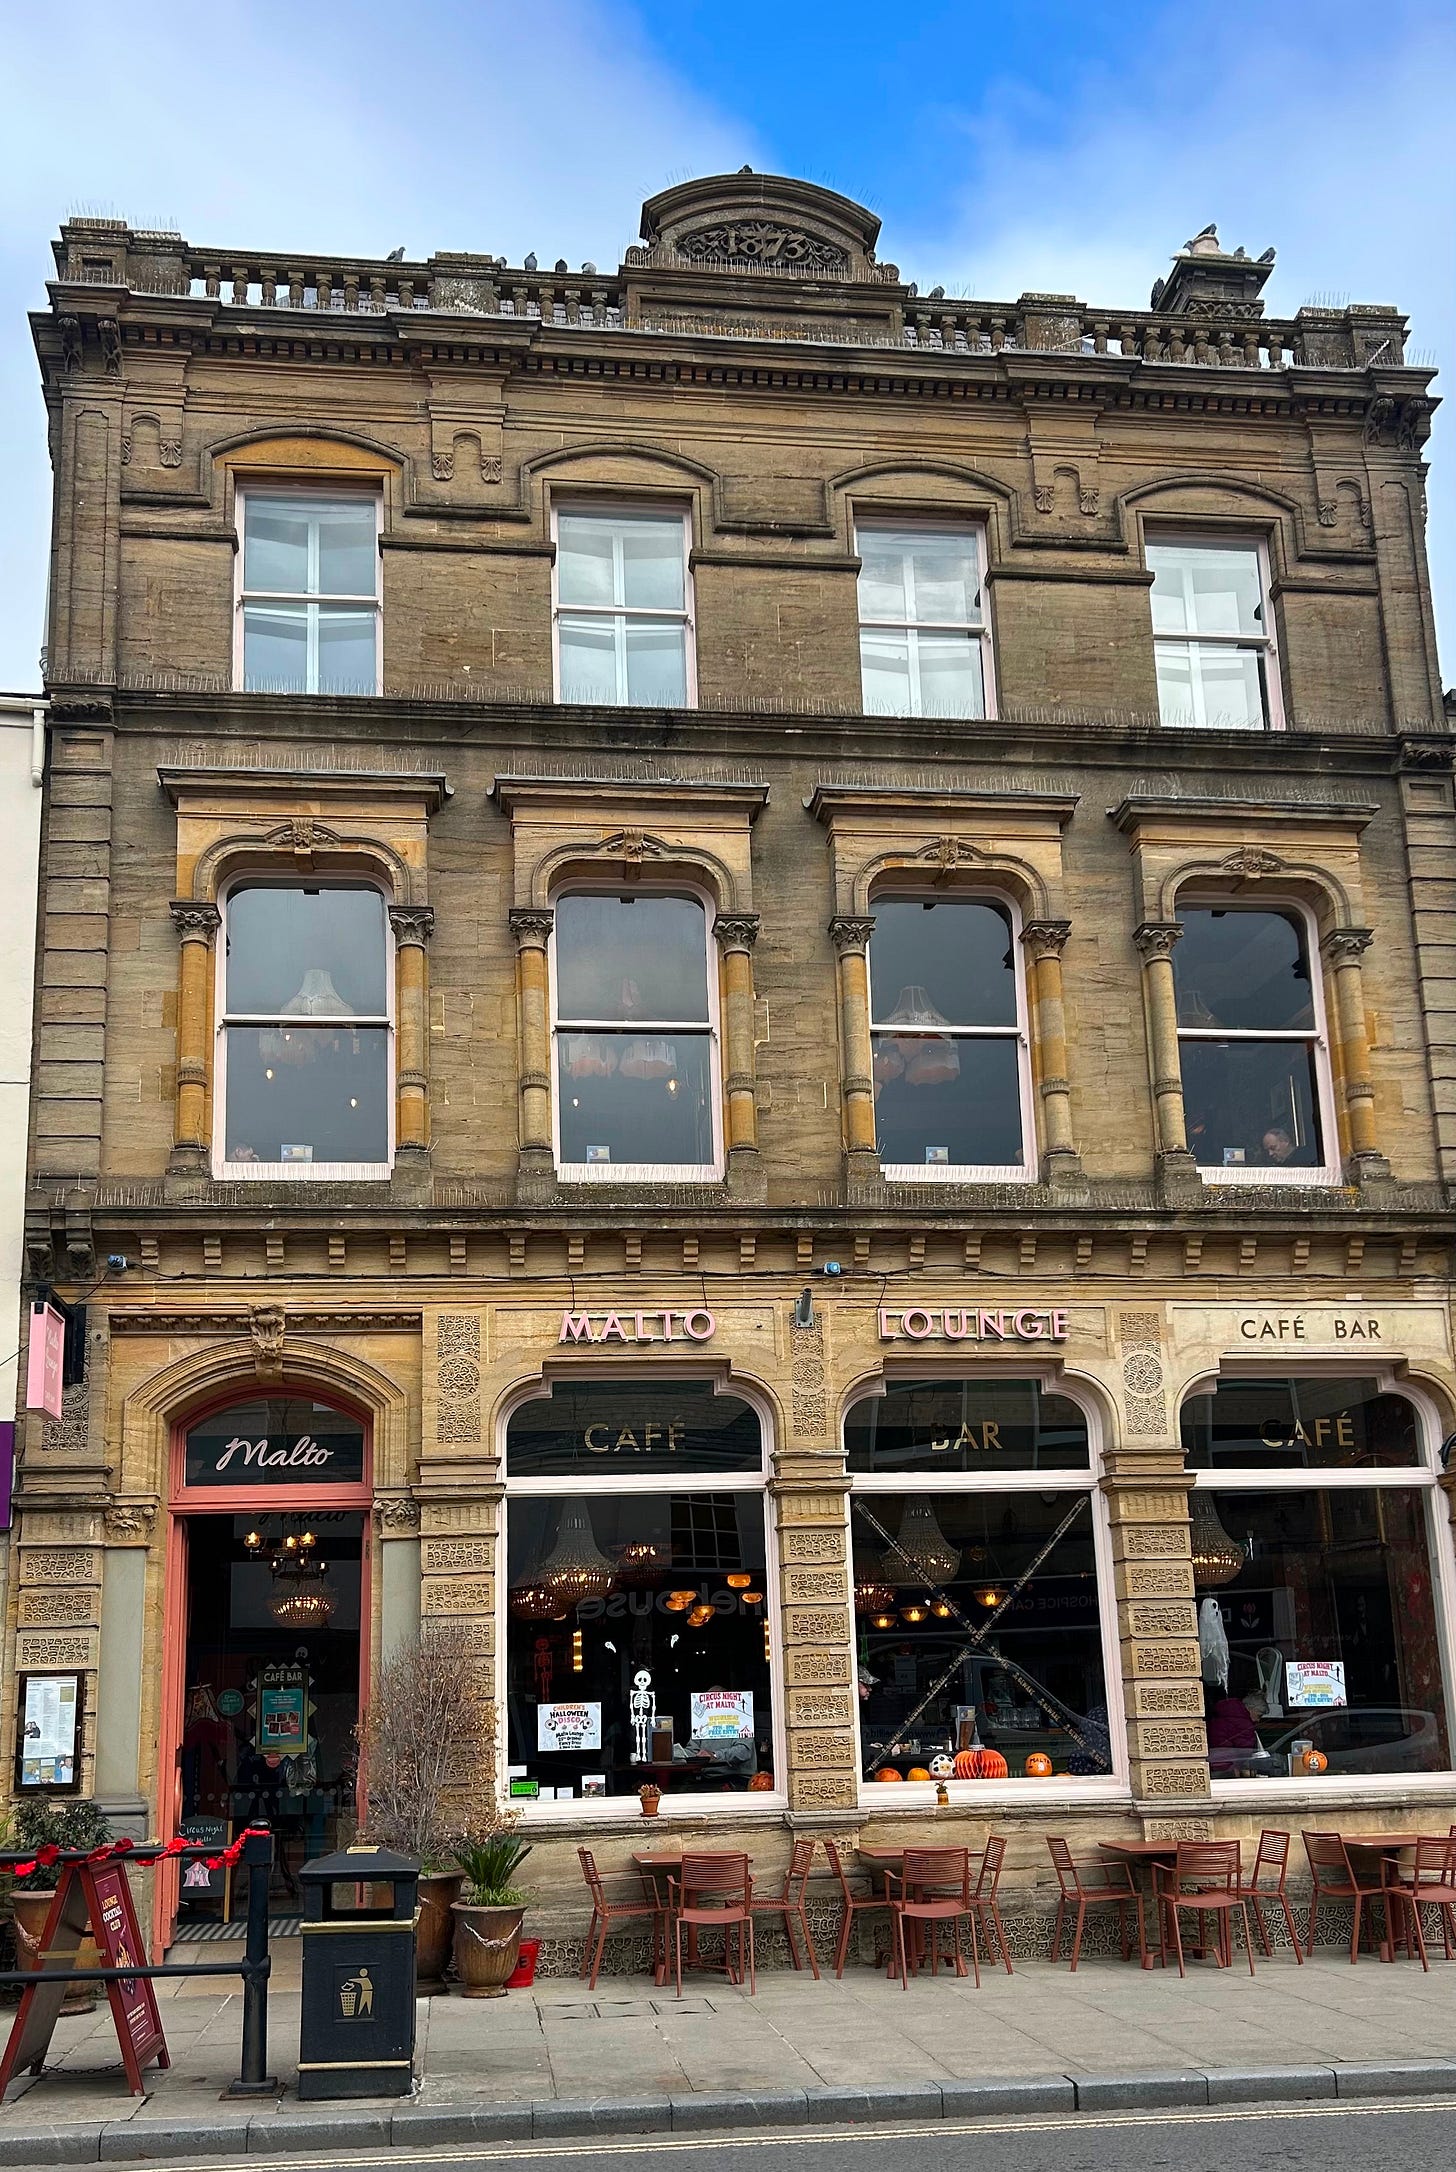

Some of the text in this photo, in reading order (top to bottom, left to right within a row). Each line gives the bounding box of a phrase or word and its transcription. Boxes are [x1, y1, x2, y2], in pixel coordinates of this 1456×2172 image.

[726, 222, 808, 260] 1873
[559, 1308, 1071, 1344] MALTO LOUNGE
[1240, 1315, 1382, 1339] CAFÉ BAR
[584, 1414, 686, 1453] CAFÉ
[931, 1421, 1003, 1450] BAR
[1259, 1411, 1355, 1447] CAFÉ
[215, 1436, 334, 1471] Malto
[263, 1670, 303, 1682] CAFÉ BAR
[1297, 1662, 1334, 1671] CIRCUS NIGHT
[699, 1692, 742, 1703] CIRCUS NIGHT
[706, 1701, 714, 1709] AT
[550, 1710, 589, 1719] HALLOWEEN
[179, 1823, 223, 1836] Circus Night
[101, 1895, 118, 1910] LOUNGE
